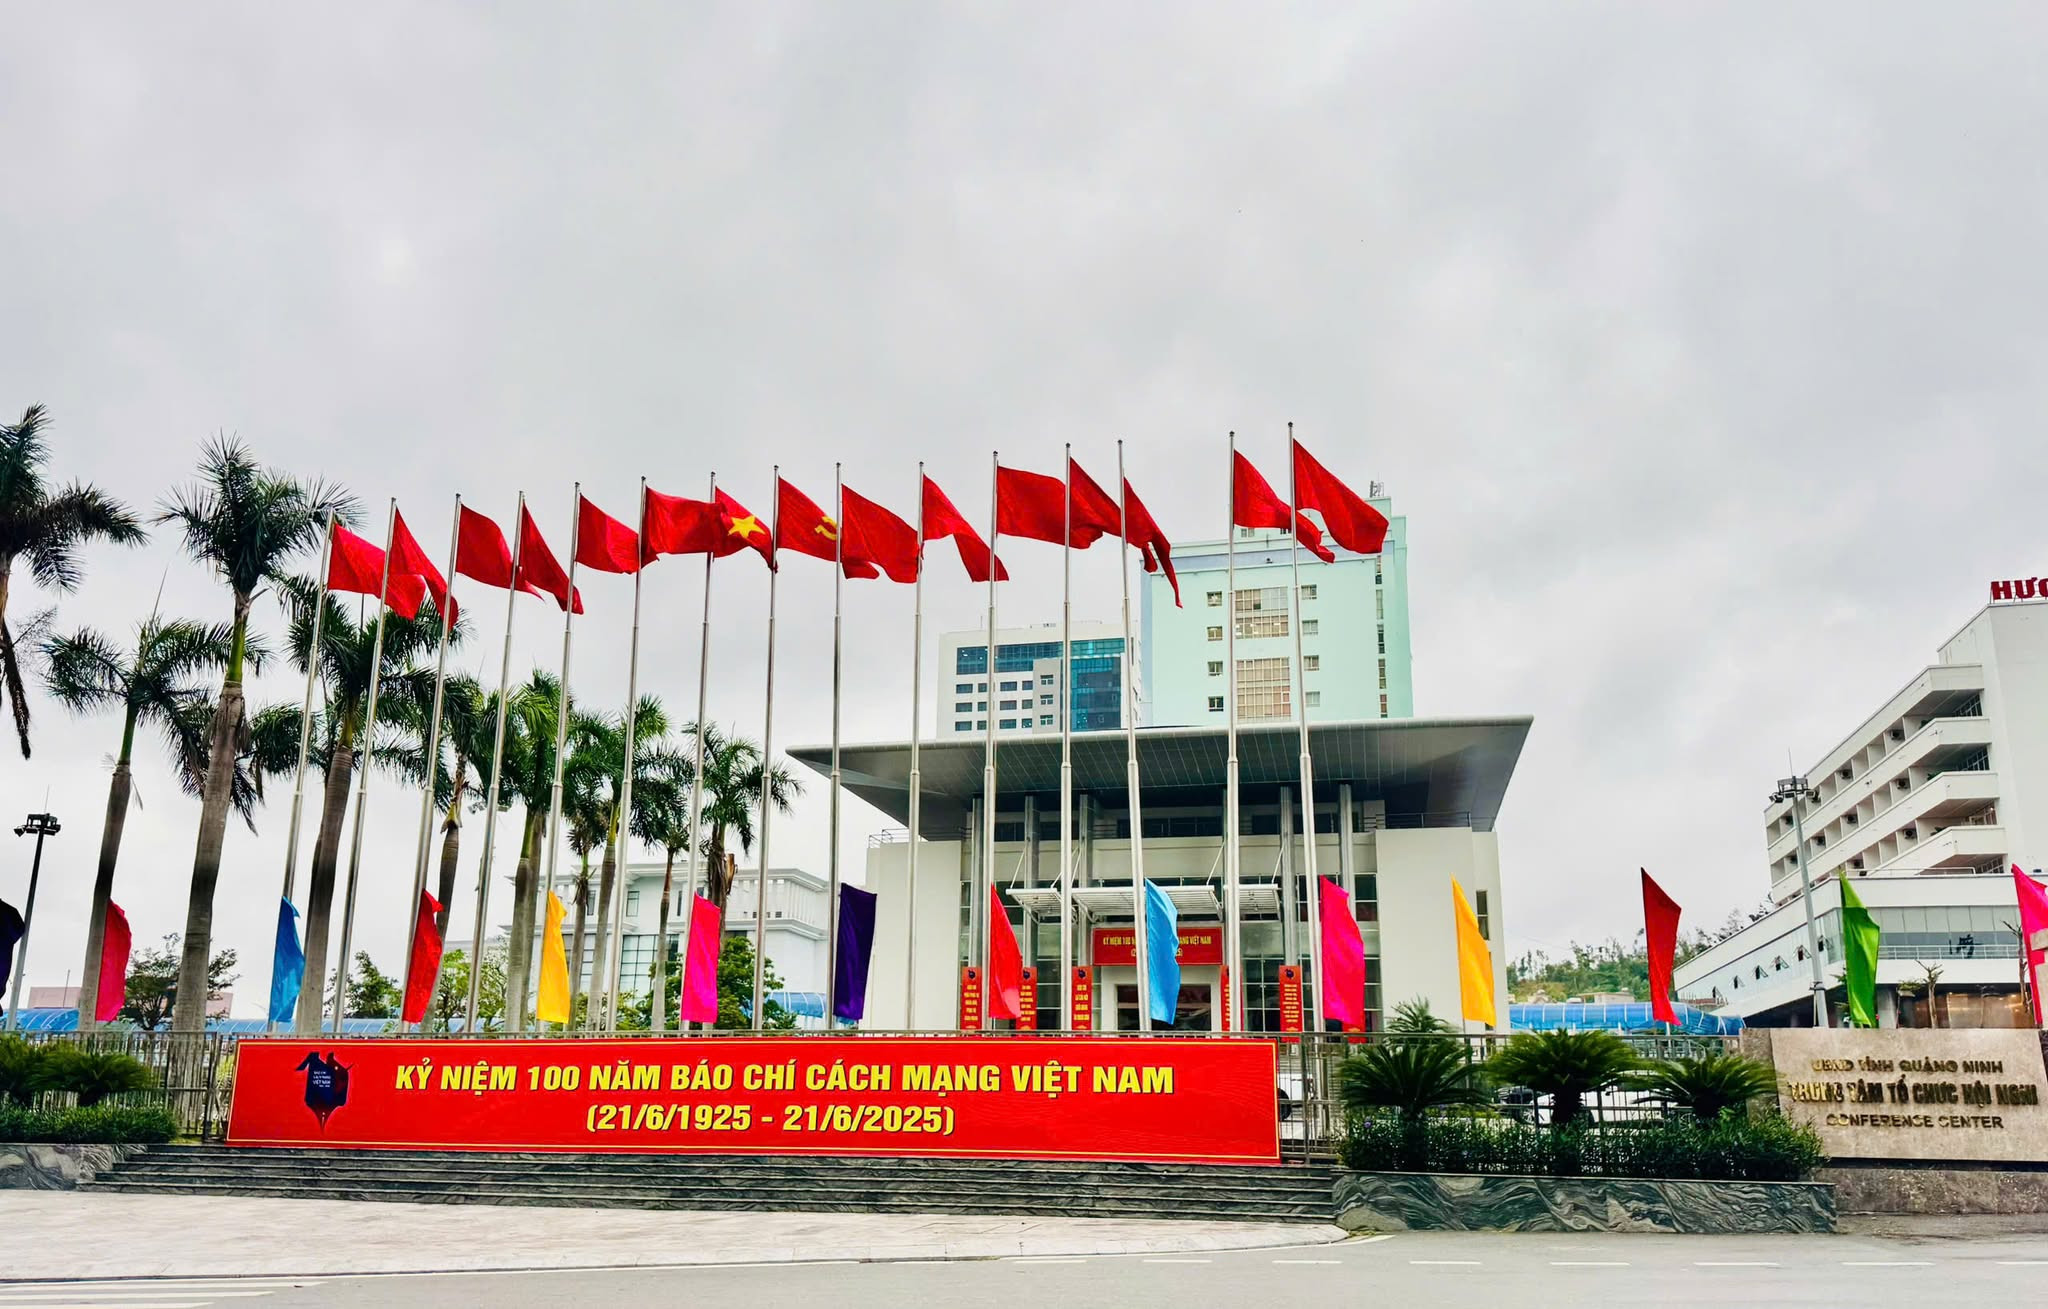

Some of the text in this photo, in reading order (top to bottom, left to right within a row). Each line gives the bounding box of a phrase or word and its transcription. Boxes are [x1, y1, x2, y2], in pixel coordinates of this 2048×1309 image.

[395, 1057, 1174, 1098] KỶ NIỆM 100 NĂM BÁO CHÍ CÁCH MẠNG VIỆT NAM
[1811, 1059, 1855, 1072] UBND
[1962, 1060, 2003, 1074] NINH
[1787, 1081, 1845, 1102] TRUNG
[1846, 1078, 1885, 1104] TÂM
[1886, 1073, 1910, 1104] TỔ
[1912, 1081, 1959, 1105] CHỨC
[1961, 1080, 1992, 1109] HỘI
[586, 1103, 752, 1133] (21/6/1925
[782, 1104, 954, 1136] 21/6/2025)
[1826, 1113, 2005, 1129] CONFERENCE CENTER
